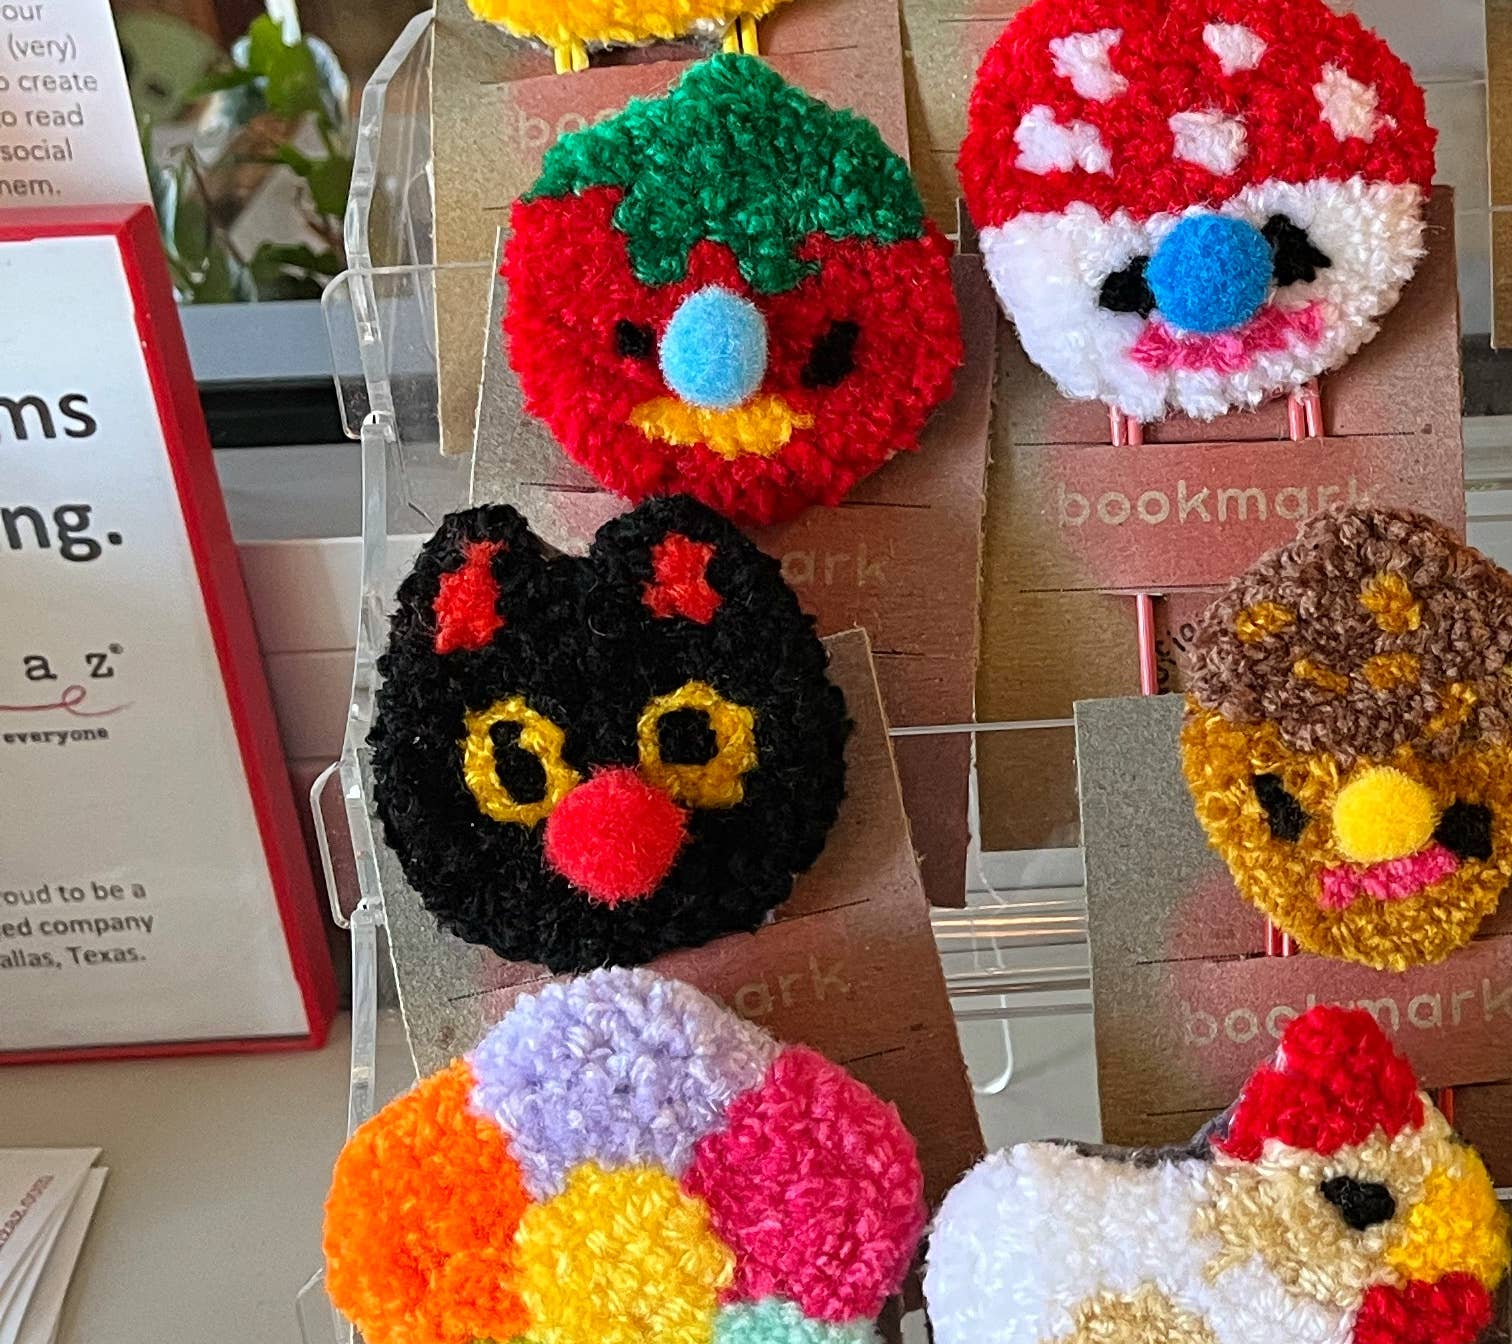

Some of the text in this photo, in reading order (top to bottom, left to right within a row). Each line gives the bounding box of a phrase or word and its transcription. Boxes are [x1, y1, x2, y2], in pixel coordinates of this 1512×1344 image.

[0, 4, 43, 22] our
[8, 33, 77, 63] (very)
[18, 72, 98, 92] create
[25, 102, 84, 127] read
[0, 137, 73, 161] social
[0, 393, 97, 441] ms
[1, 503, 123, 562] ng.
[3, 727, 110, 745] everyone
[0, 881, 147, 906] oud to be a
[0, 914, 154, 937] ed company
[0, 945, 147, 970] allas, Texas.
